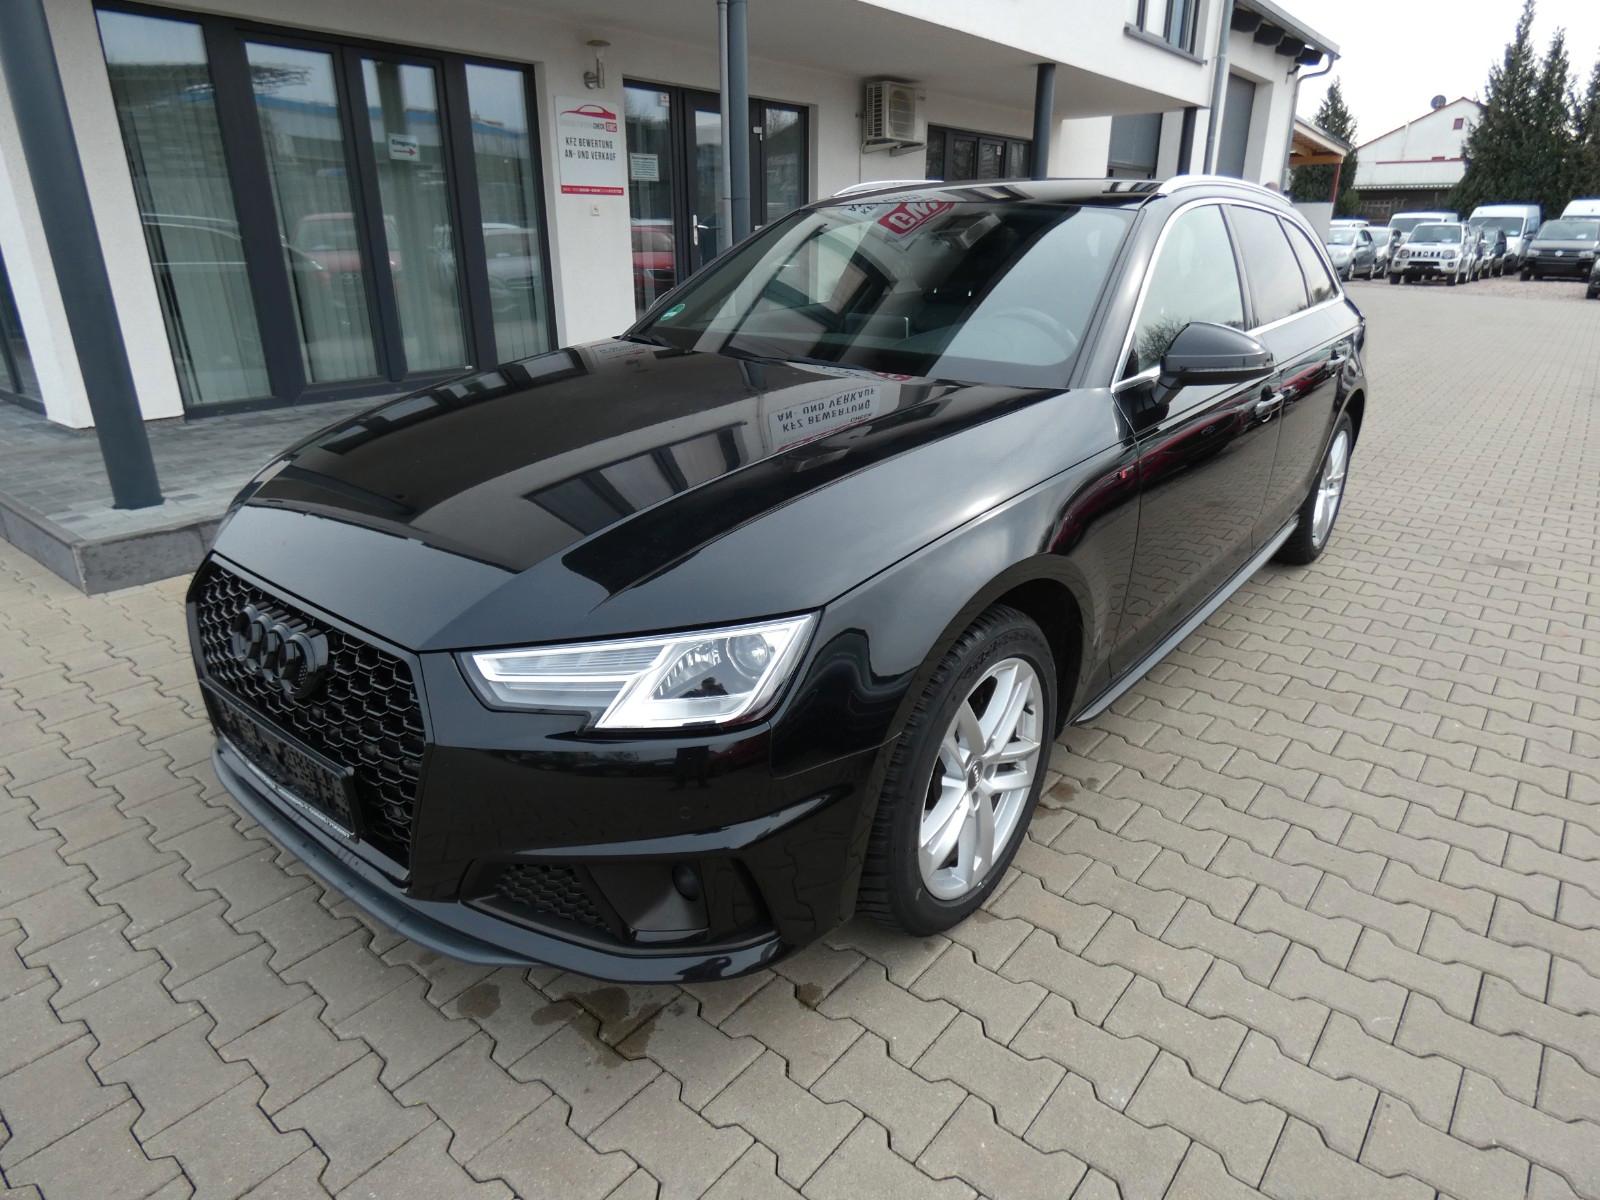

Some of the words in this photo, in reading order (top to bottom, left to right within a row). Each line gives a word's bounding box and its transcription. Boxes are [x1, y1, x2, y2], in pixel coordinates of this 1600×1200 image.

[565, 137, 577, 147] KFZ
[578, 138, 613, 149] BEWERTUNG
[564, 149, 577, 158] AN-
[577, 150, 590, 160] UND
[590, 151, 617, 161] VERKAUF
